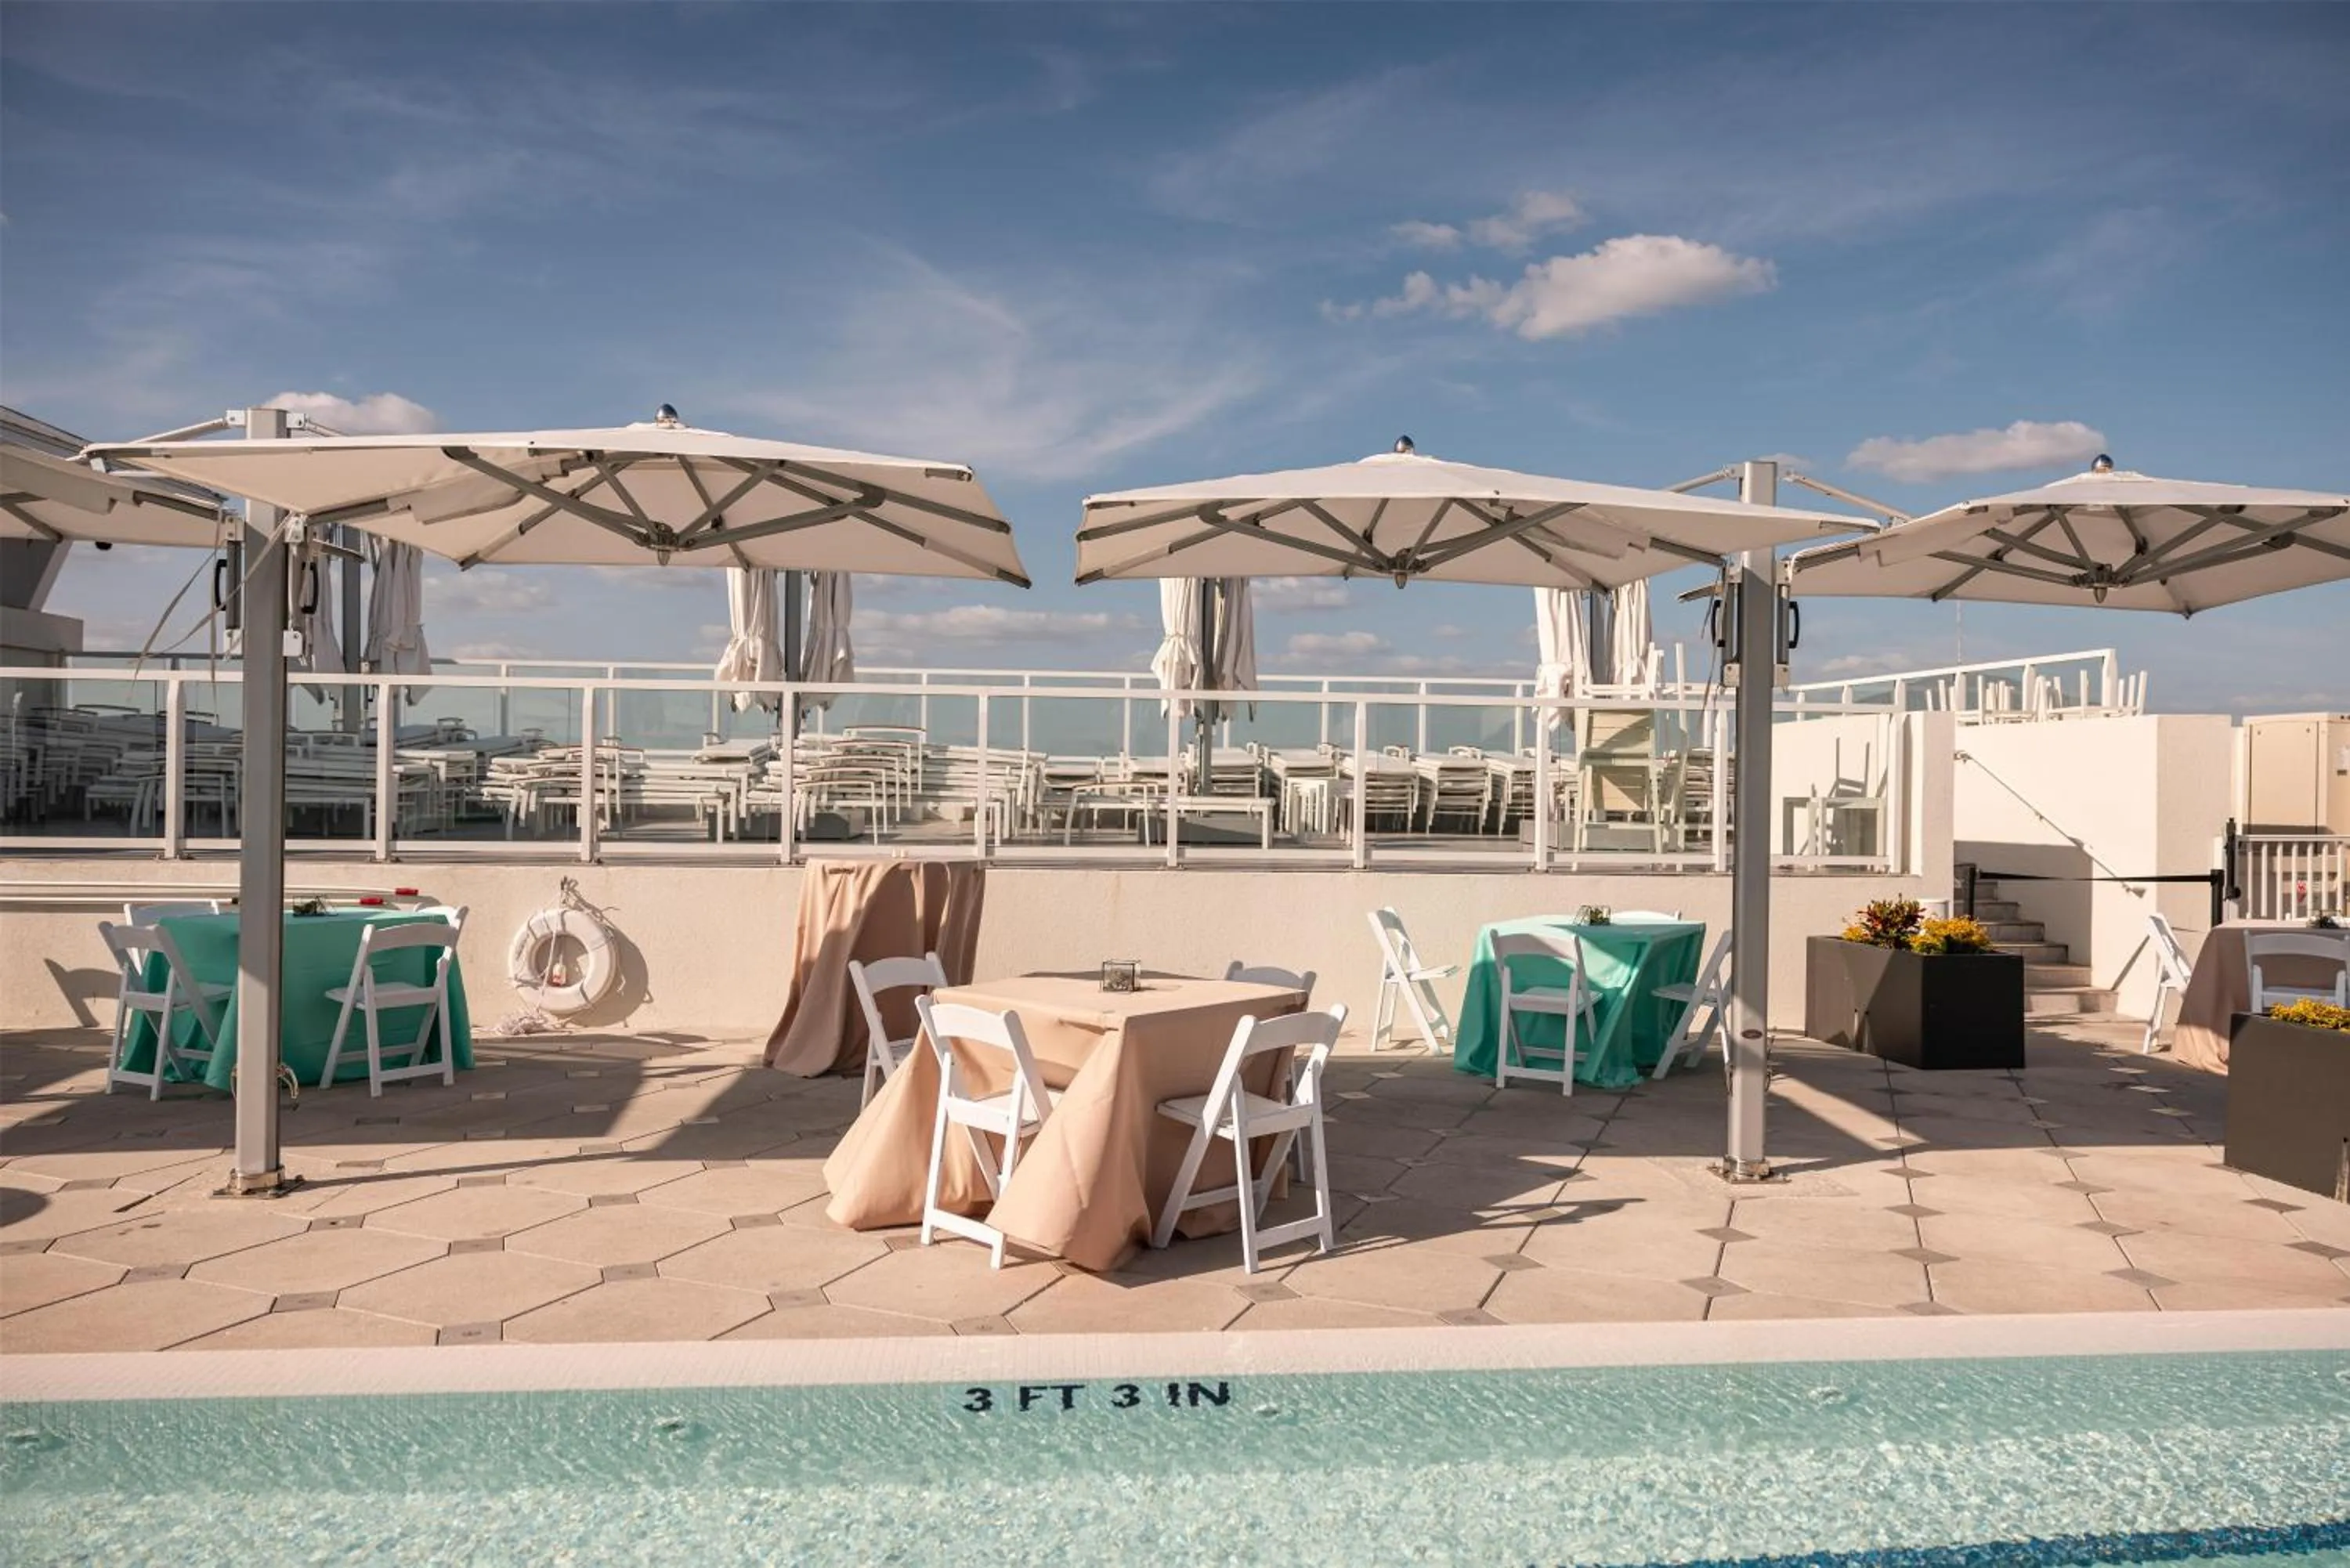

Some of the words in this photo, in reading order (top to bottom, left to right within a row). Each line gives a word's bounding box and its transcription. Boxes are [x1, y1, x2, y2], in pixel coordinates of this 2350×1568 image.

[963, 1387, 993, 1412] 3
[1019, 1384, 1085, 1412] FT
[1111, 1383, 1141, 1409] 3
[1167, 1382, 1231, 1407] IN
